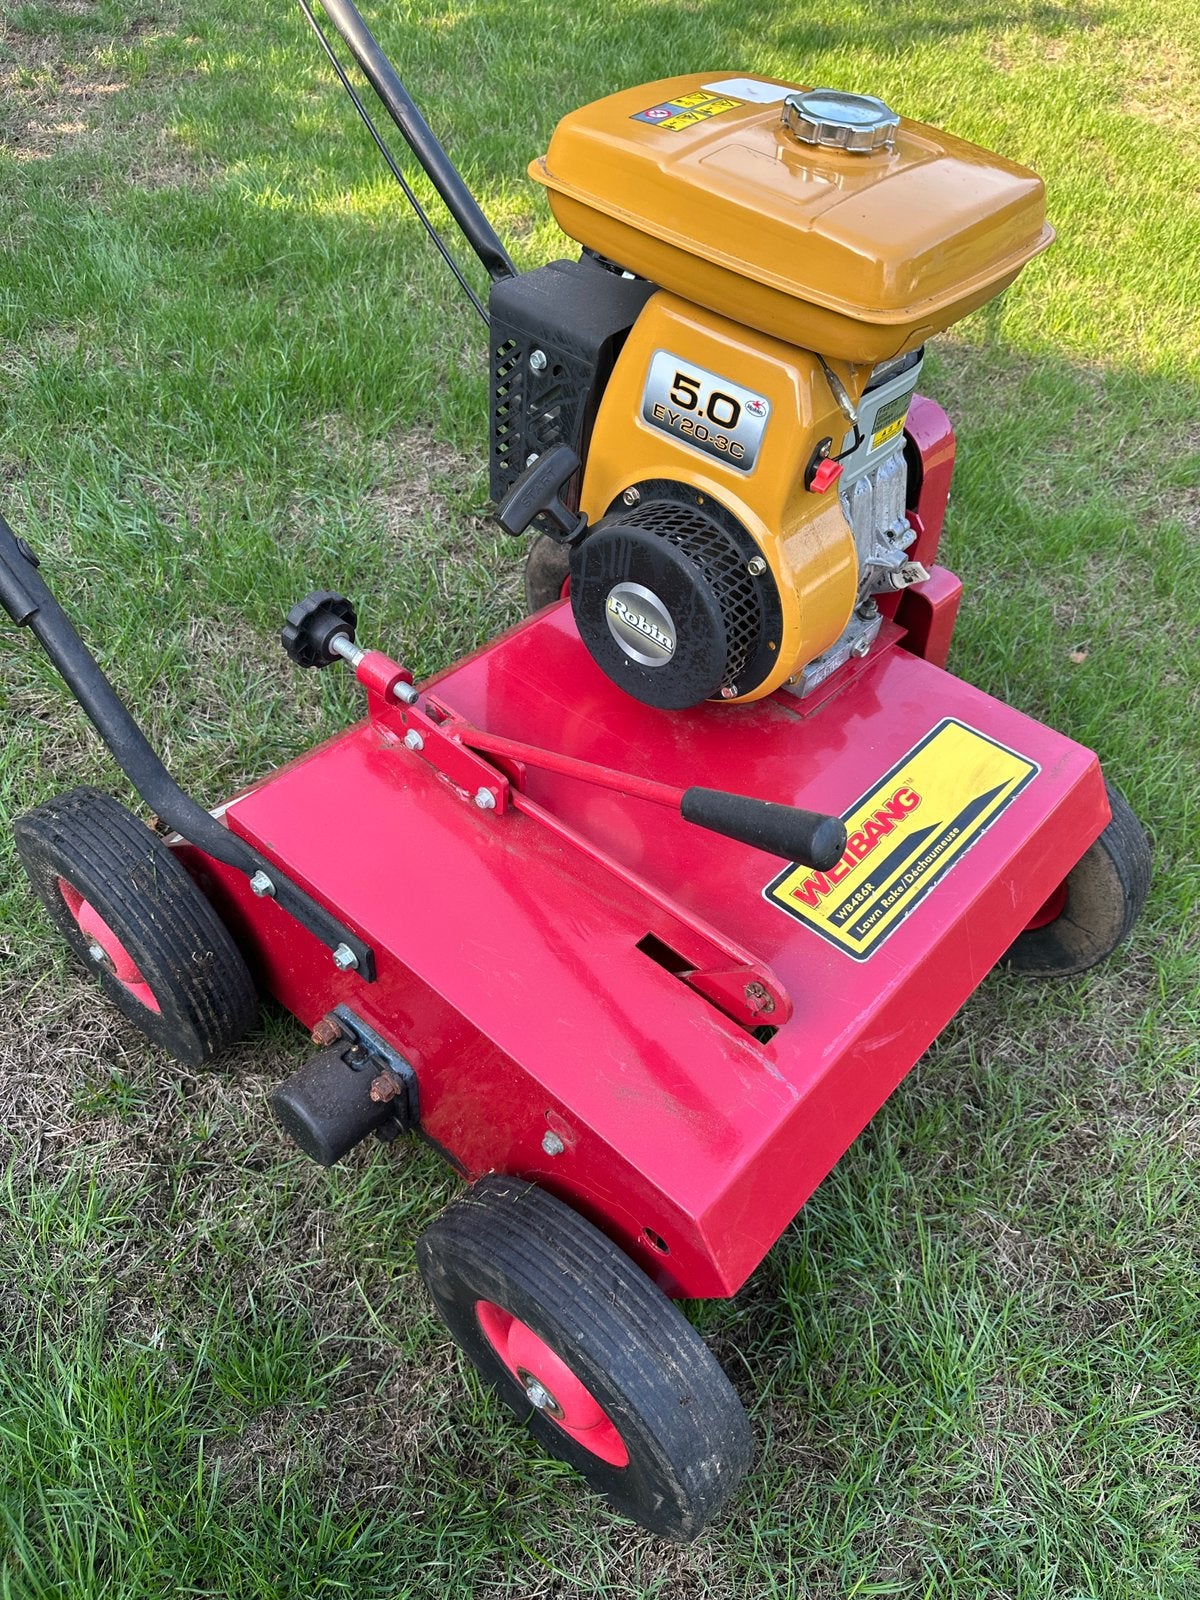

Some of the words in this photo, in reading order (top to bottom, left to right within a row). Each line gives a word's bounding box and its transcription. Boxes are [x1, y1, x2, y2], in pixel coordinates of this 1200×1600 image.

[669, 371, 742, 430] 5.0
[652, 403, 746, 459] EY20-3C
[609, 595, 673, 650] Robin
[790, 786, 922, 909] WEIBANG
[835, 882, 876, 920] WB486R
[855, 908, 883, 934] Lawn
[880, 826, 961, 908] Rake/Déchaumeuse
